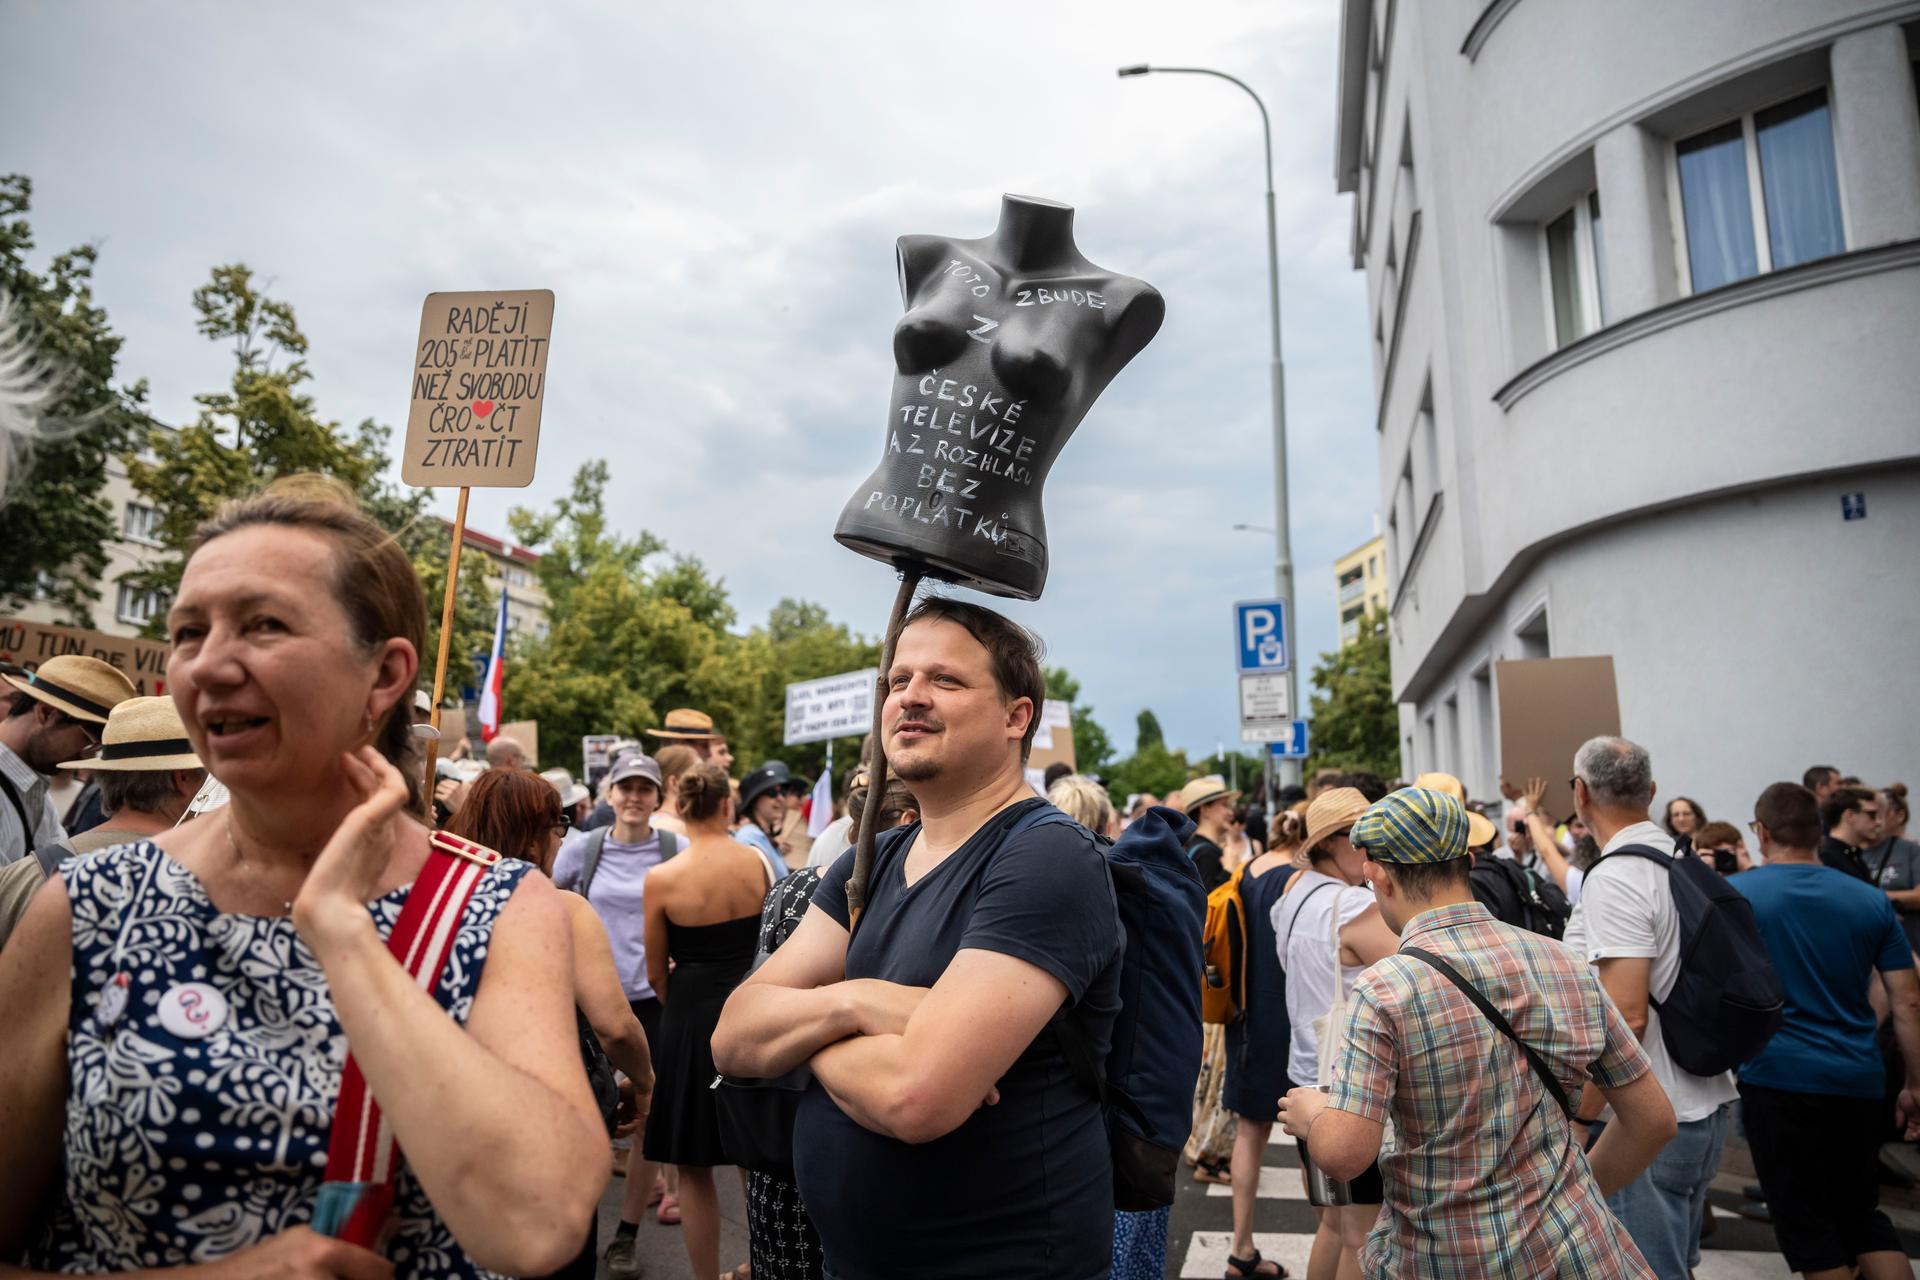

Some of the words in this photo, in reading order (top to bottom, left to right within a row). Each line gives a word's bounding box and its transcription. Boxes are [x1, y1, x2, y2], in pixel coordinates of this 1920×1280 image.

[944, 259, 990, 298] TOTO
[1015, 288, 1107, 309] ZBUDE
[446, 301, 529, 334] RADĚJI
[966, 314, 999, 344] Z
[419, 339, 460, 368] 205
[473, 335, 547, 368] PLATIT
[413, 369, 452, 400] NEŽ
[456, 372, 543, 400] SVOBODU
[919, 368, 1029, 425] ČESKÉ
[429, 402, 472, 433] ČRO
[490, 402, 520, 432] ČT
[900, 405, 1037, 462] TELEVIZE
[422, 434, 523, 467] ZTRATIT
[934, 440, 1034, 486] ROZHLASU
[917, 463, 983, 499] BEZ
[863, 491, 1009, 545] POPLATKŮ
[1245, 608, 1276, 652] P
